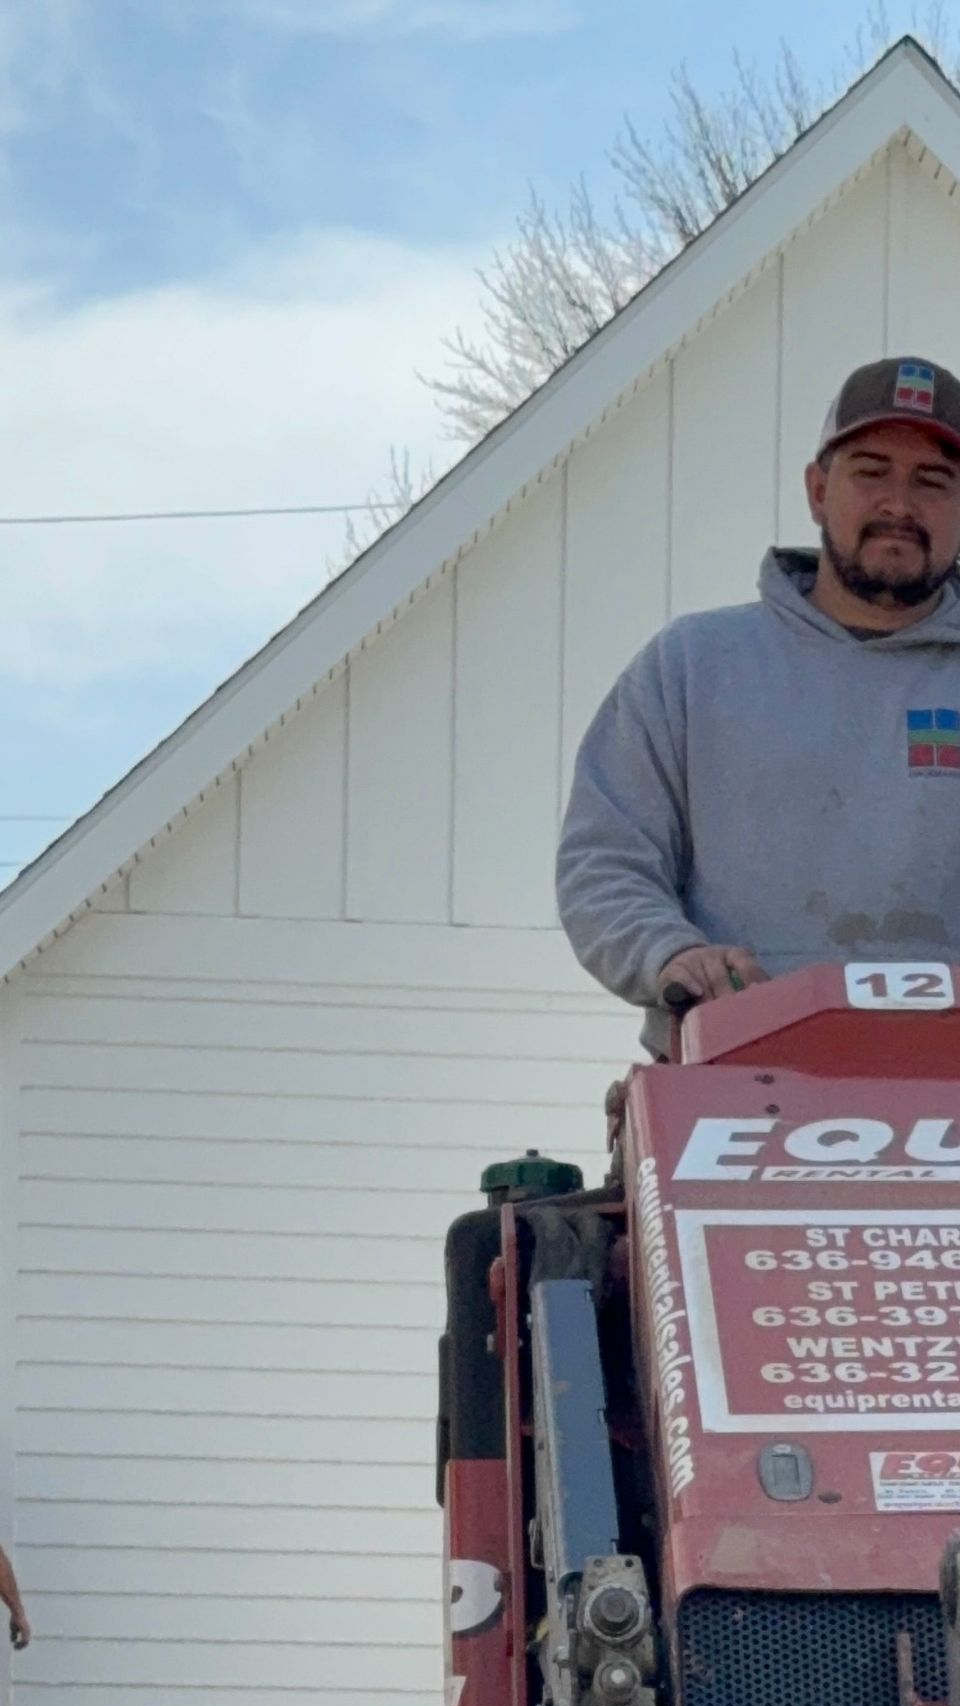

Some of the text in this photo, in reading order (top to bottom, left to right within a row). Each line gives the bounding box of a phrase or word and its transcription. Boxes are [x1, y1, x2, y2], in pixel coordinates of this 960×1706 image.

[855, 973, 946, 998] 12
[770, 1169, 937, 1179] RENTAL
[805, 1227, 851, 1248] ST
[807, 1280, 860, 1301] ST
